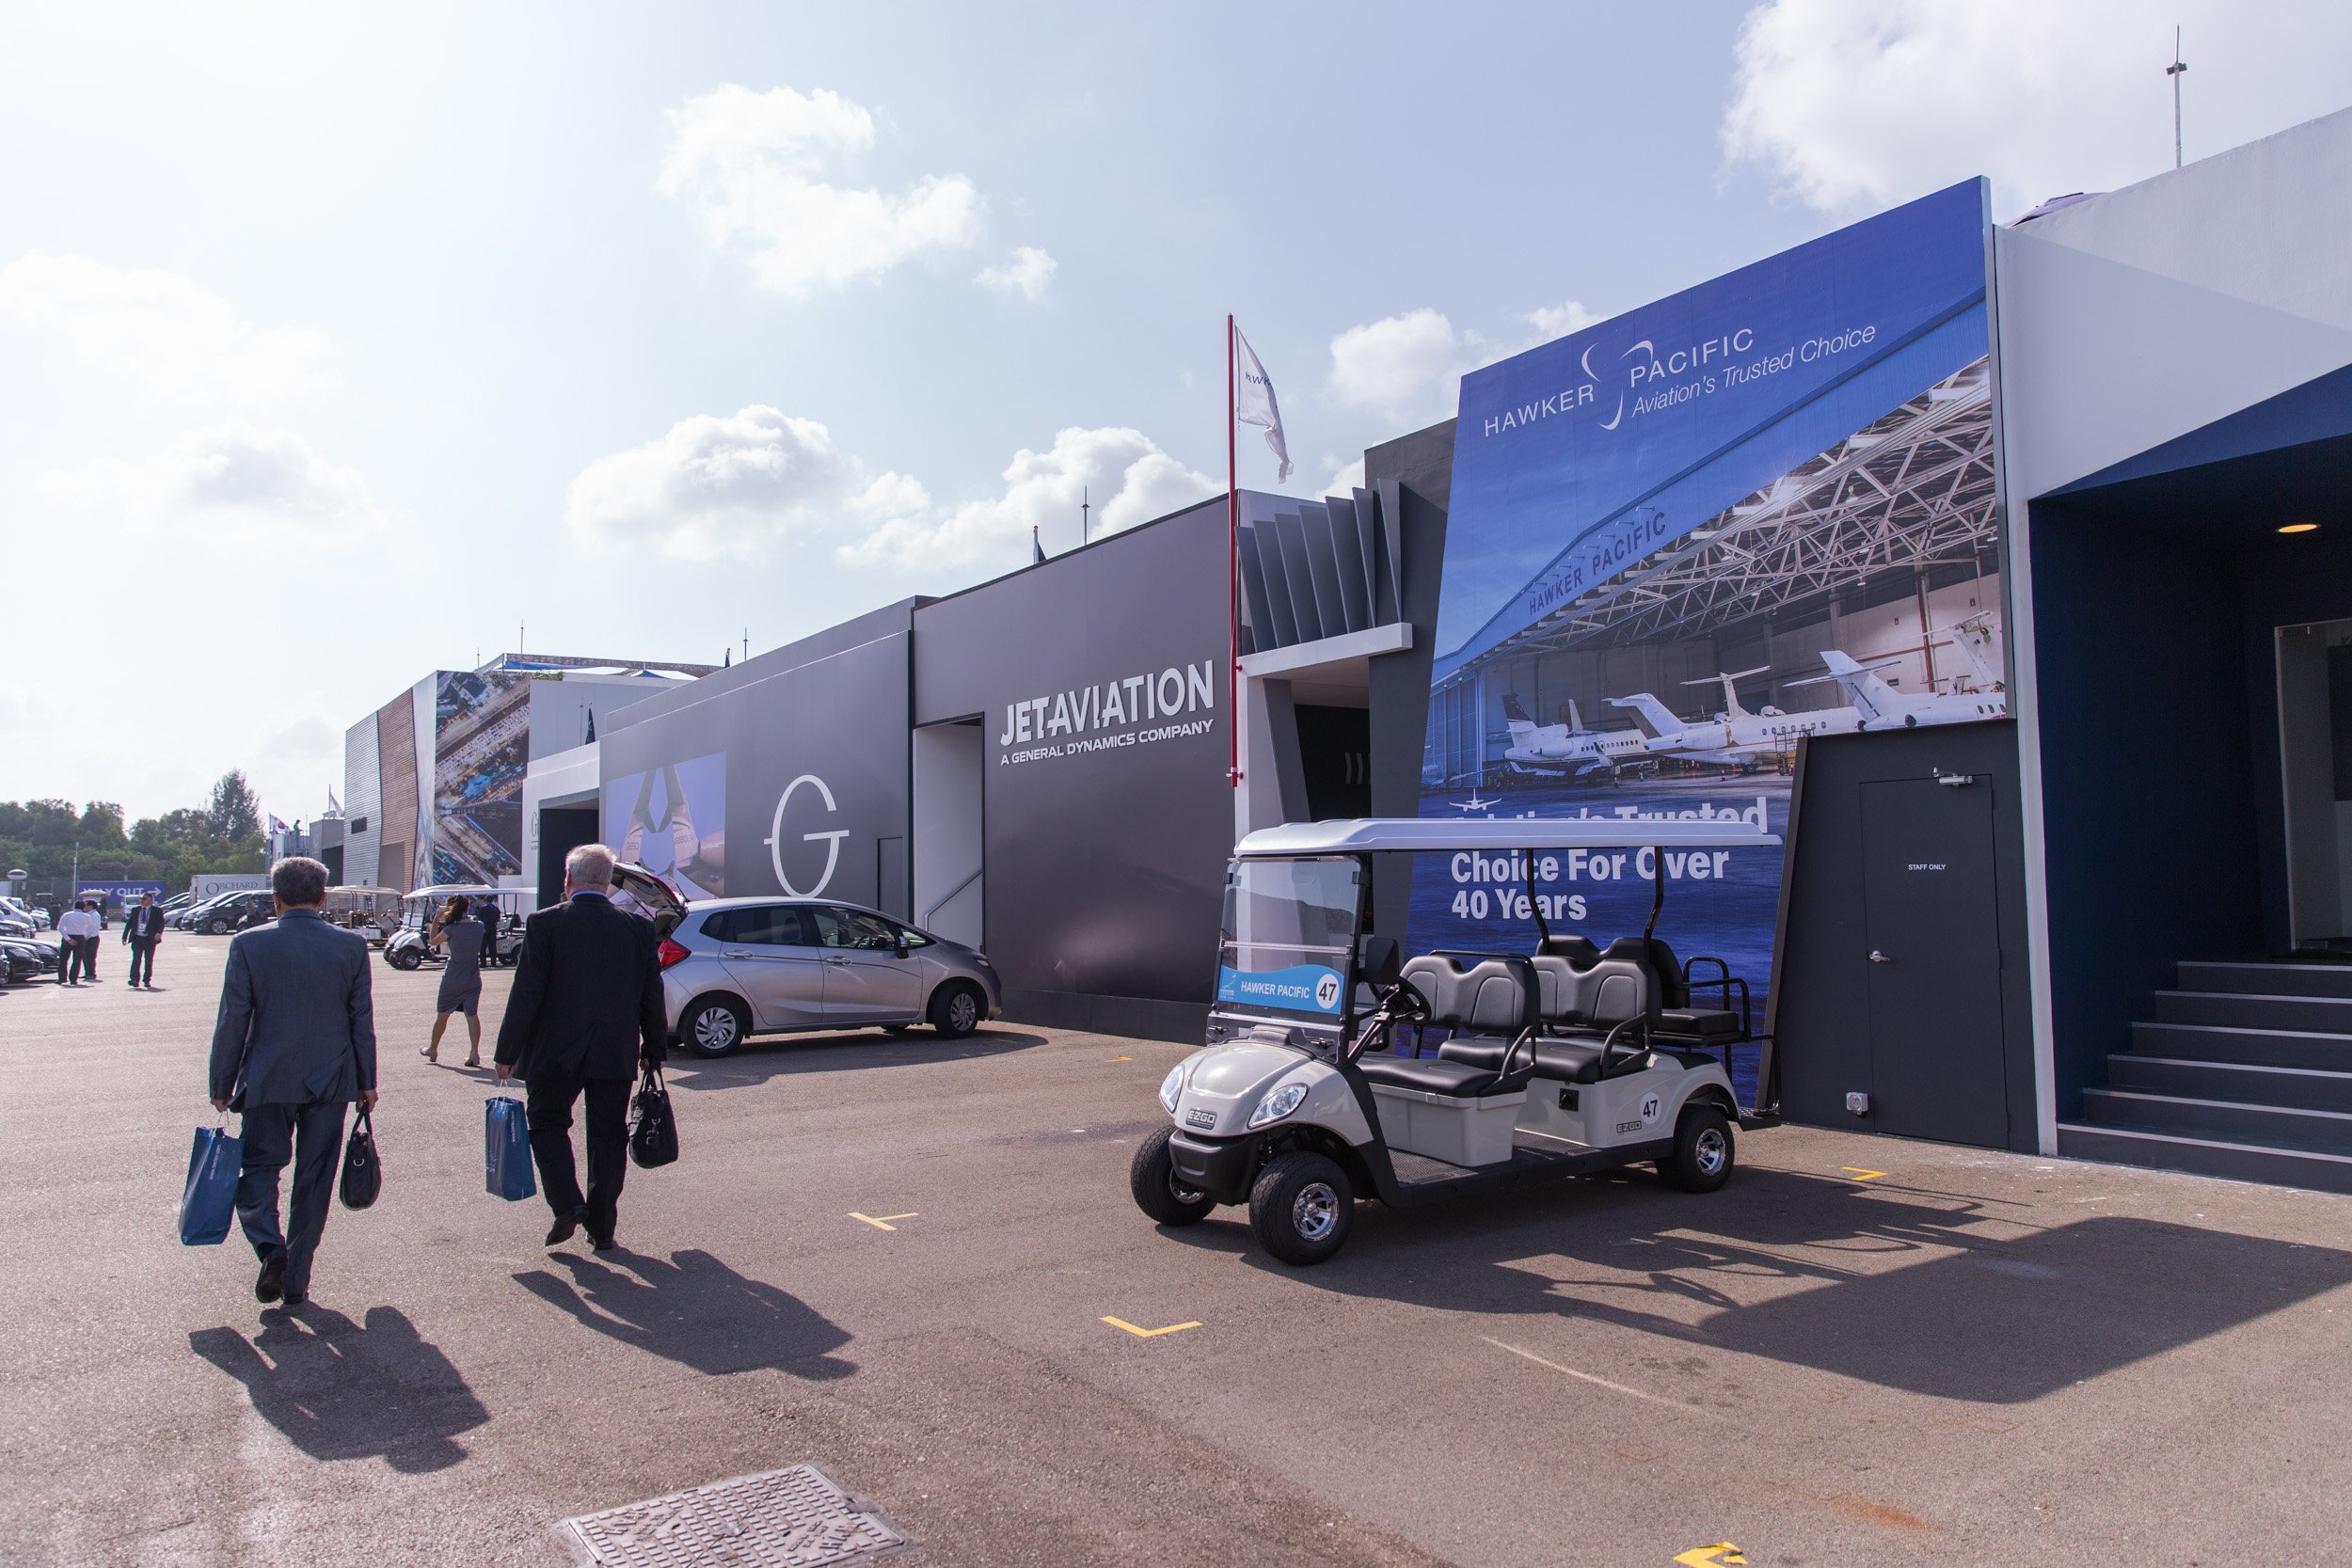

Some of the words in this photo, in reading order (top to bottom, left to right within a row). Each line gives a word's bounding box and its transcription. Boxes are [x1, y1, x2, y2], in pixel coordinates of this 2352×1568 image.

[1485, 383, 1595, 437] HAWKER
[1629, 328, 1754, 388] PACIFIC
[1631, 376, 1715, 418] Aviation's
[1723, 346, 1793, 388] Trusted
[1801, 325, 1876, 363] Choice
[1529, 567, 1583, 615] HAWKER
[1592, 512, 1666, 576] PACIFIC
[1000, 753, 1009, 766] A
[1011, 746, 1064, 764] GENERAL
[1067, 733, 1136, 755] DYNAMICS
[1138, 719, 1214, 742] COMPANY
[1452, 848, 1559, 883] Choice
[1568, 848, 1626, 881] For
[1635, 847, 1729, 880] Over
[117, 888, 144, 896] OUT
[206, 882, 259, 895] ORCHARD
[1452, 890, 1488, 920] 40
[1495, 889, 1587, 921] Years
[1241, 981, 1275, 995] HAWKER
[1277, 986, 1310, 999] PACIFIC
[1318, 983, 1337, 1001] 47
[1644, 1100, 1658, 1117] 47
